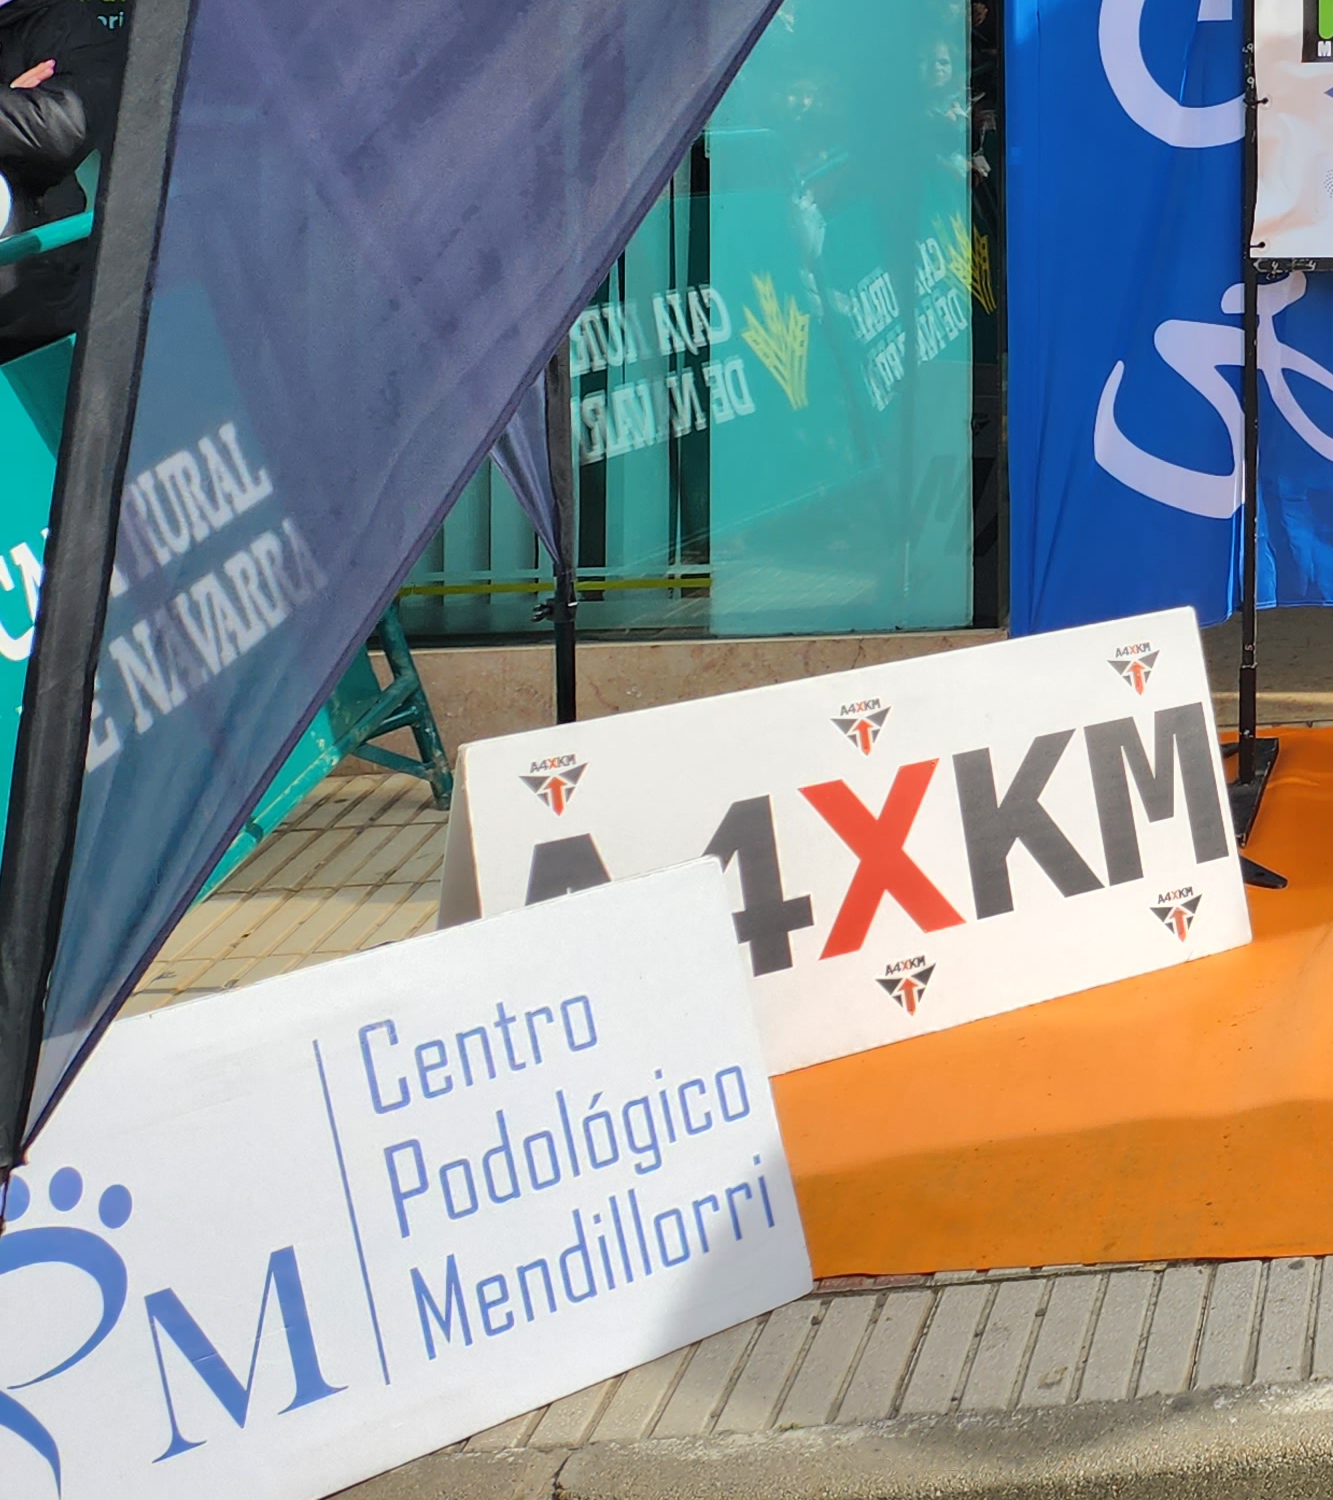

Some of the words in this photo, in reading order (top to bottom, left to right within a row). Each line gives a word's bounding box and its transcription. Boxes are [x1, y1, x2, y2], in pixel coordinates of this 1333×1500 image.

[1114, 642, 1152, 660] A4XKM
[839, 698, 882, 718] A4XKM
[529, 753, 577, 774] A4XKM
[1156, 885, 1194, 906] A4XKM
[884, 955, 927, 977] A4XKM
[358, 993, 600, 1115] Centro
[384, 1063, 751, 1239] Podológico
[410, 1155, 777, 1362] Mendillorri
